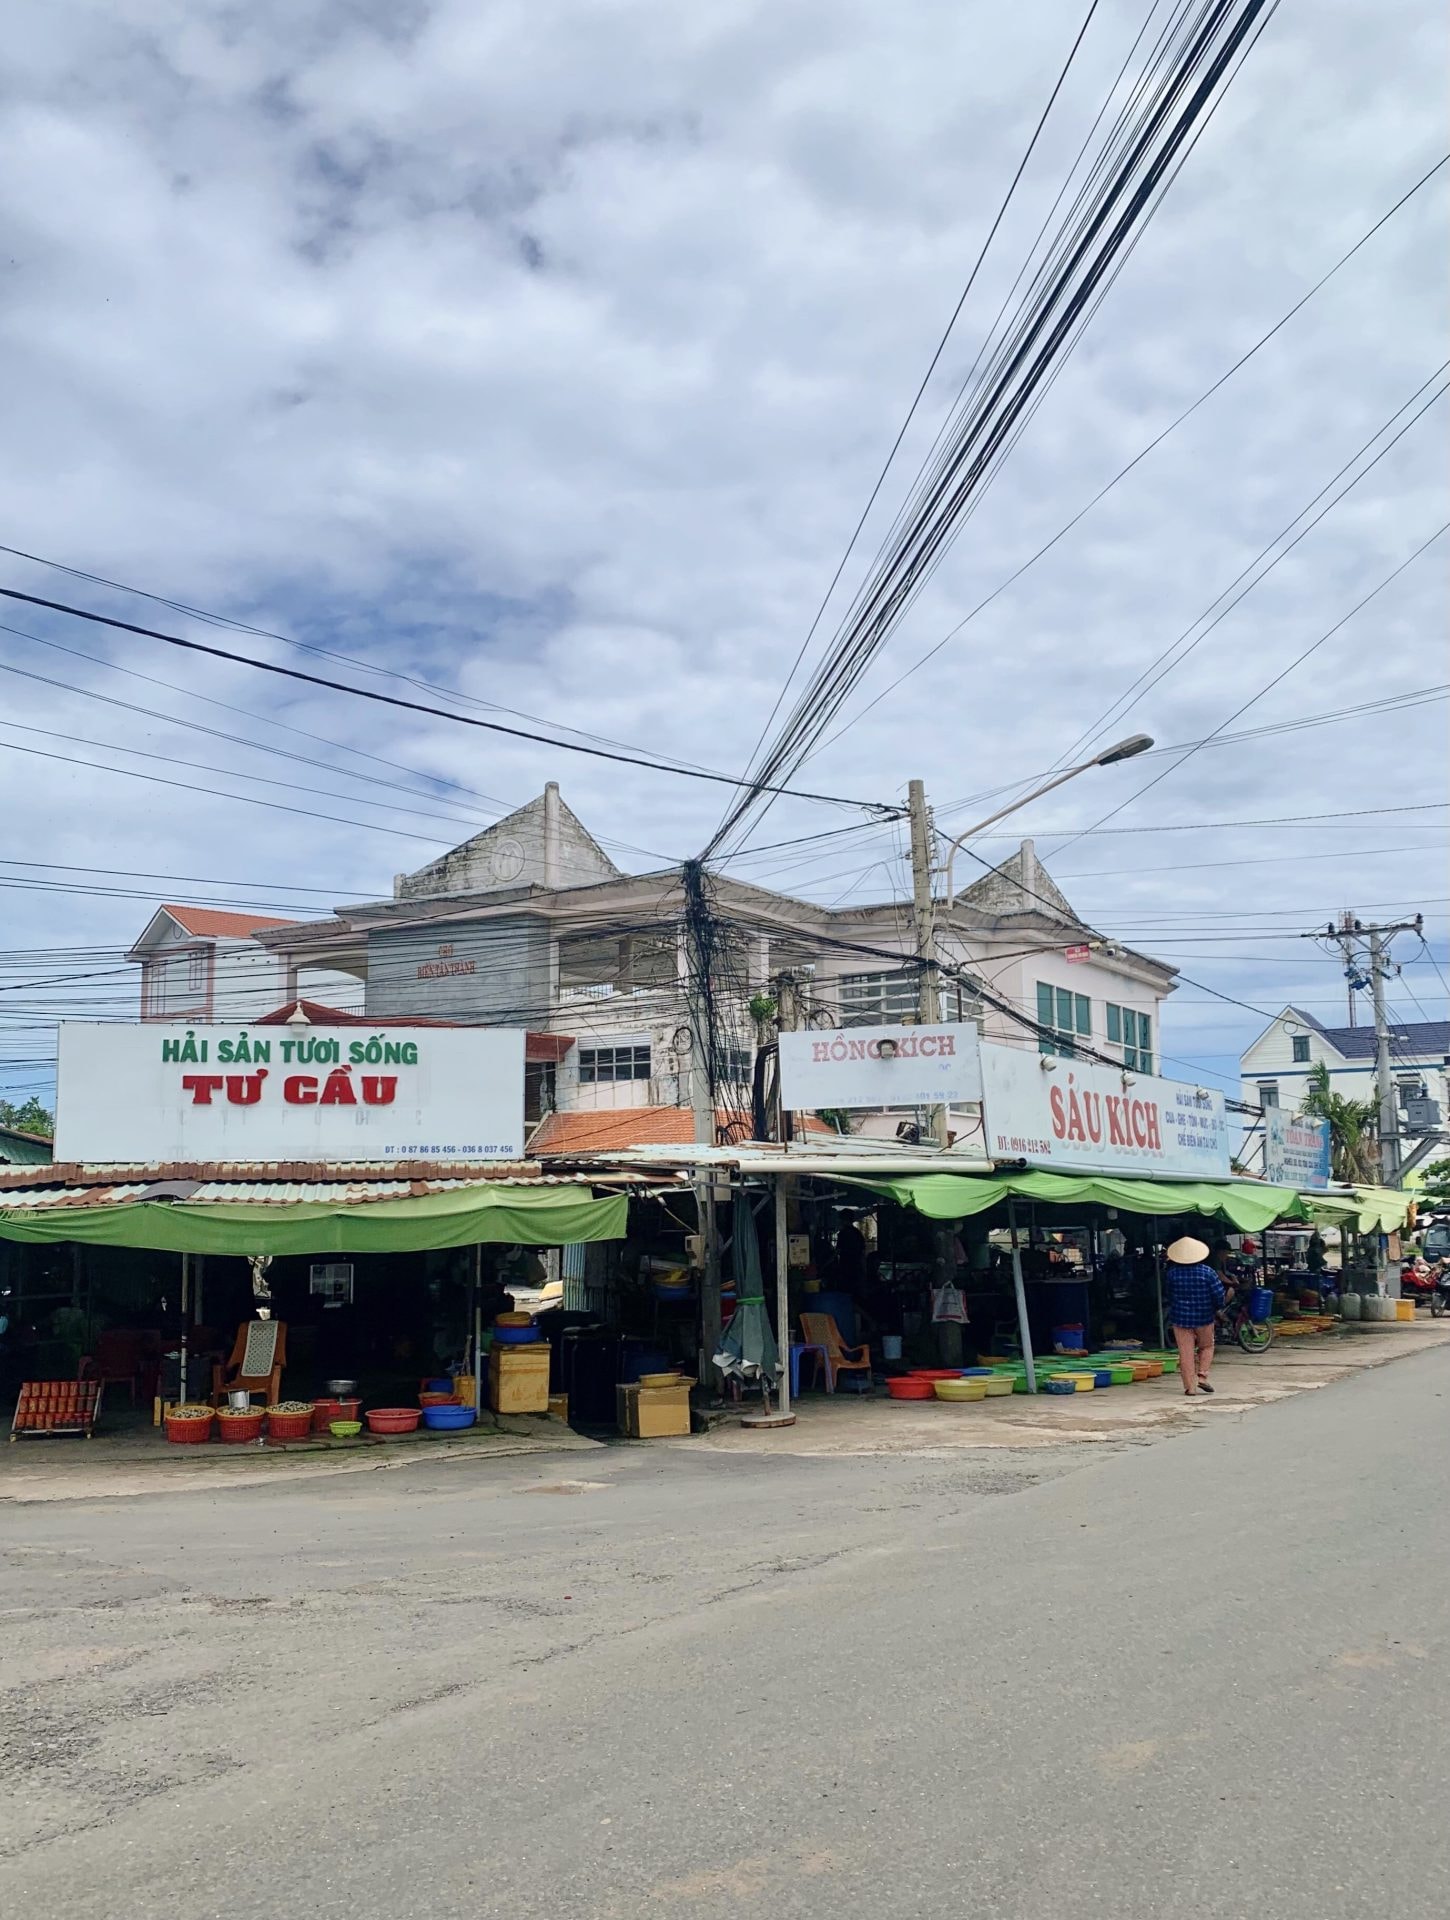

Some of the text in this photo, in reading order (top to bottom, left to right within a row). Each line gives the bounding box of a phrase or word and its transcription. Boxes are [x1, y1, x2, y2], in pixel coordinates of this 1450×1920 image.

[162, 1030, 419, 1065] HẢI SẢN TƯƠI SỐNG
[894, 1031, 956, 1058] KÍCH
[182, 1064, 398, 1106] TƯ CẦU
[1050, 1072, 1162, 1150] SÁU KÍCH
[401, 1145, 407, 1153] 0
[408, 1145, 418, 1153] 87
[419, 1145, 429, 1154] 86
[431, 1145, 440, 1154] 85
[442, 1145, 456, 1154] 456
[462, 1145, 476, 1153] 036
[477, 1145, 483, 1153] 8
[484, 1145, 498, 1153] 037
[499, 1145, 513, 1153] 456
[1010, 1136, 1027, 1152] 0916
